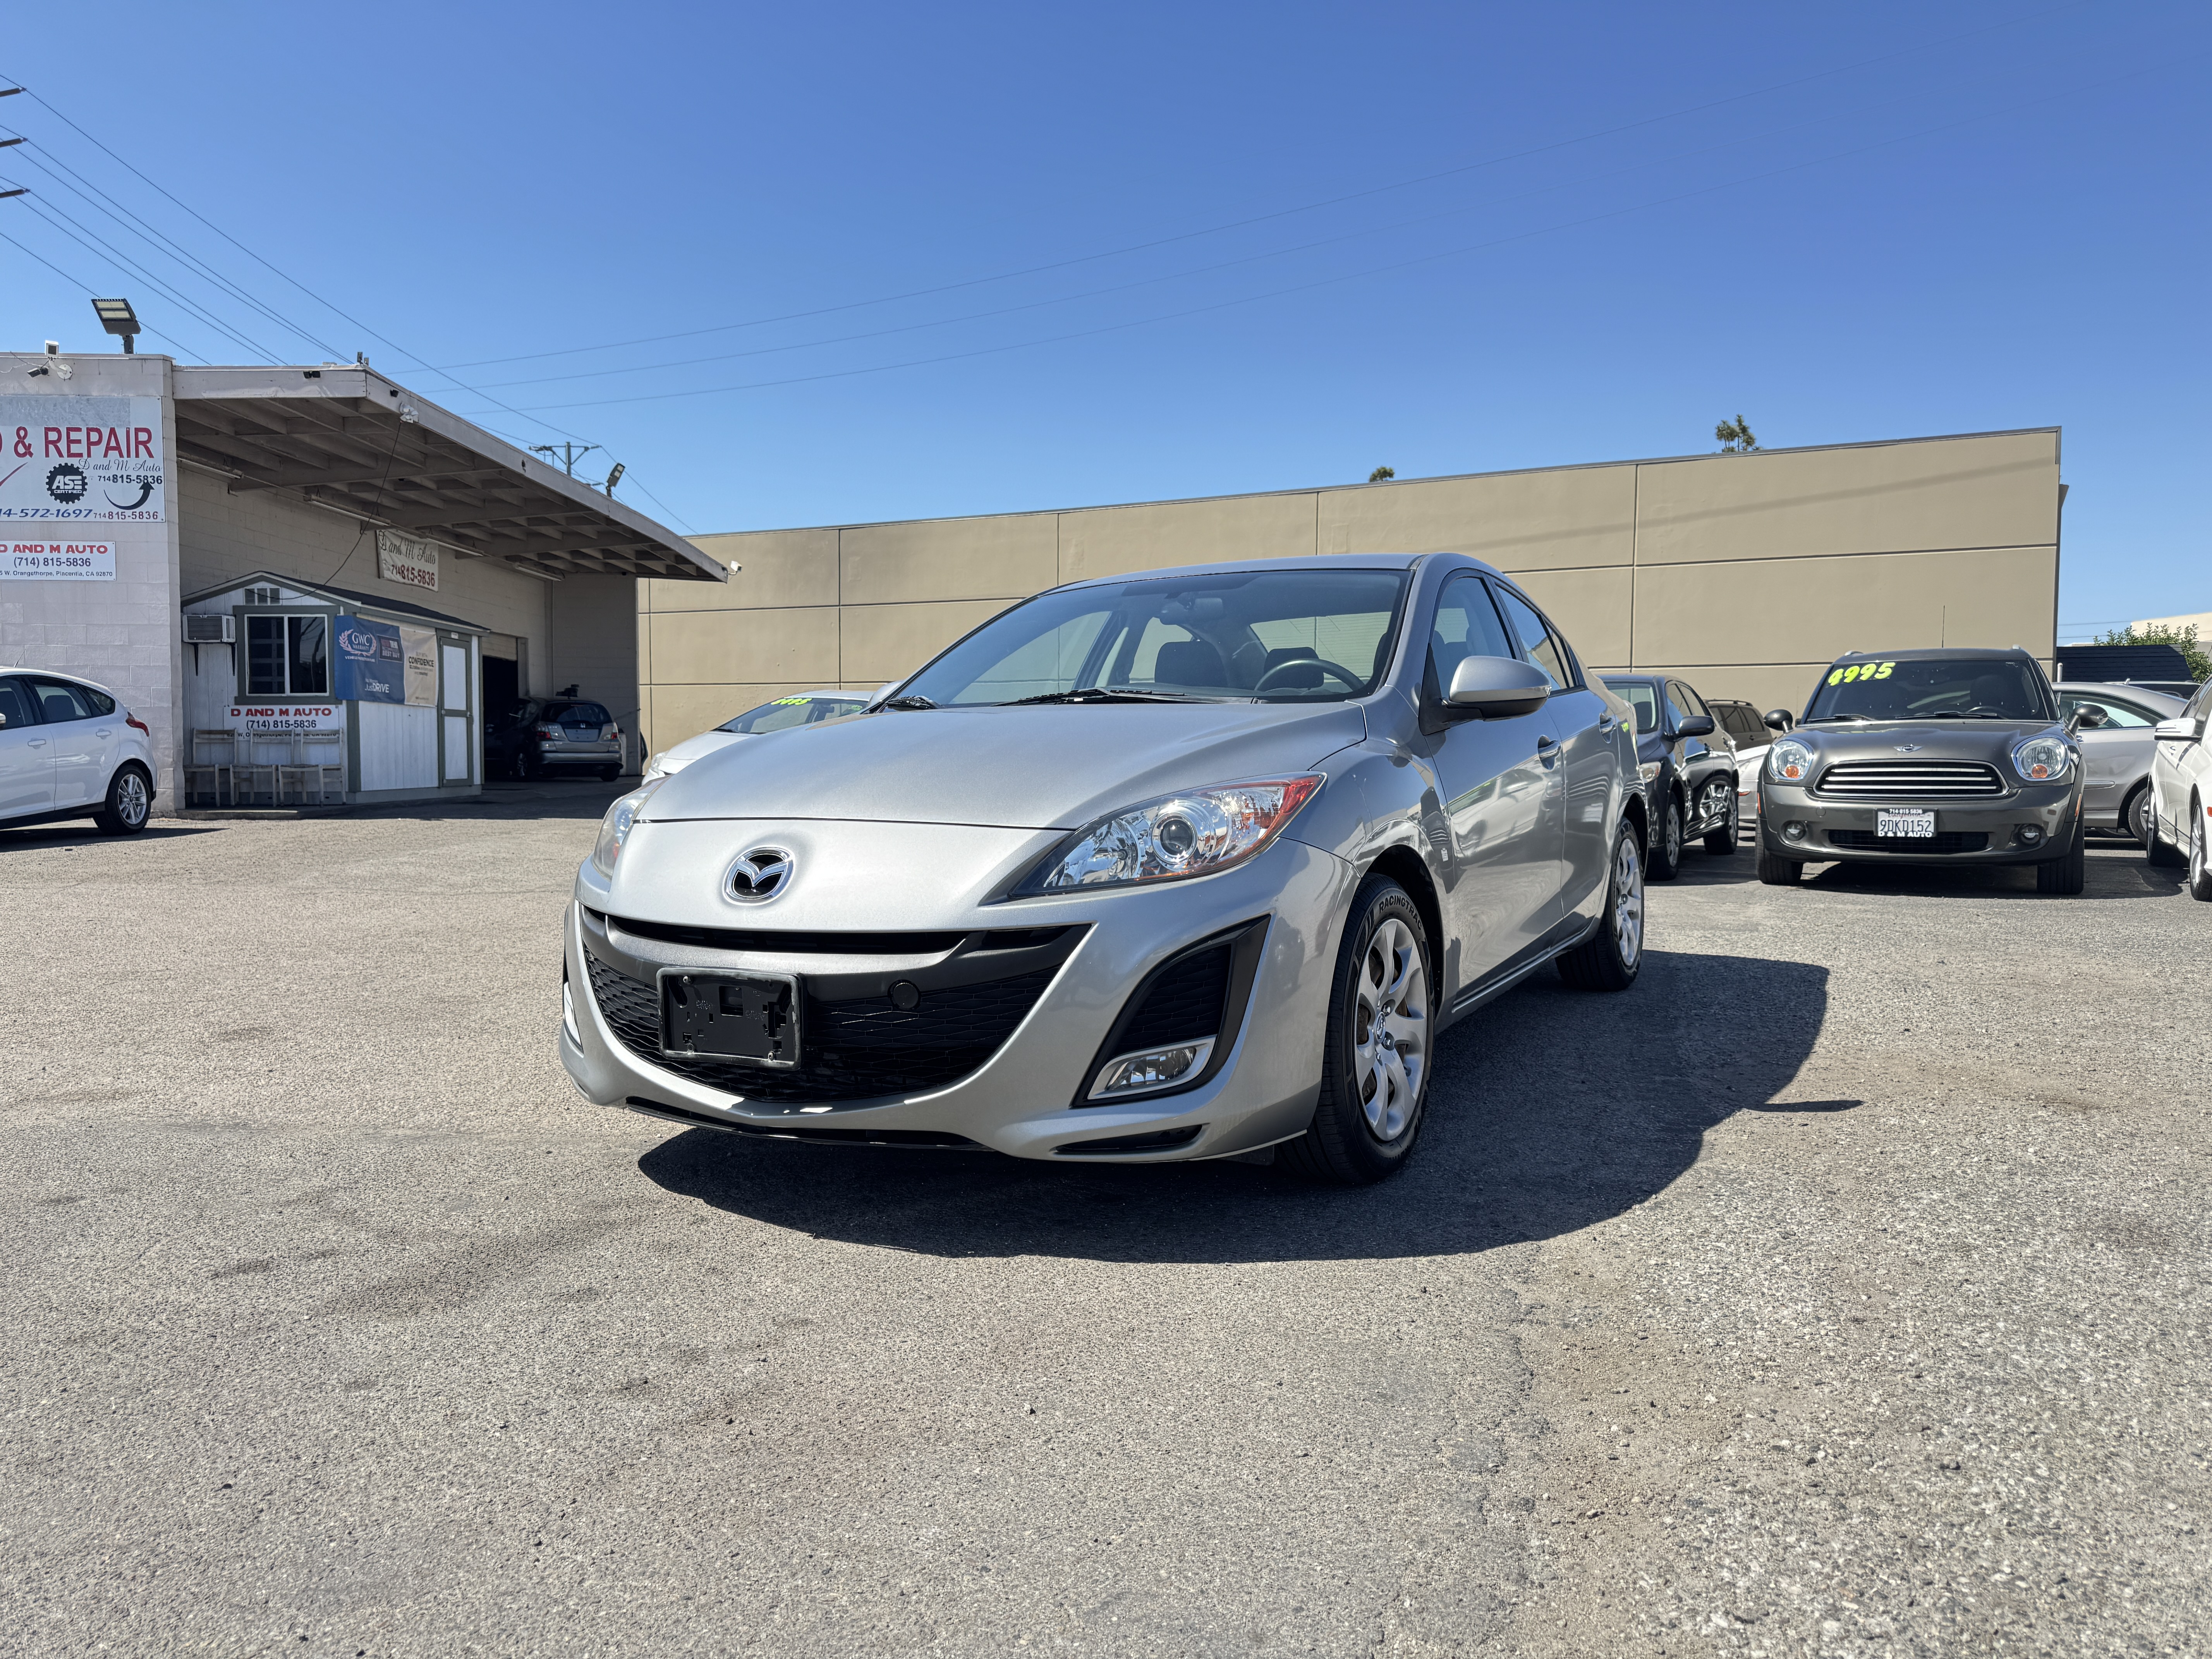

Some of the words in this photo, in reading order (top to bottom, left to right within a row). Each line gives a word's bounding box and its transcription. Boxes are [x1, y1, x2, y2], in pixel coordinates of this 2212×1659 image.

[14, 426, 34, 458] &
[44, 427, 155, 459] REPAIR
[93, 460, 112, 471] and
[114, 459, 130, 471] M
[133, 460, 162, 472] Auto
[52, 476, 82, 489] ASE
[13, 544, 45, 553] AND
[49, 544, 60, 553] M
[65, 545, 108, 554] AUTO
[388, 538, 403, 555] and
[405, 538, 415, 559] M
[417, 543, 435, 565] Auto
[14, 557, 40, 568] (714)
[43, 558, 91, 567] 815-5836
[352, 632, 370, 646] GWC
[409, 656, 434, 667] CONFIDENCE
[1828, 662, 1896, 686] 4995
[231, 708, 241, 716] D
[246, 708, 275, 716] AND
[279, 708, 289, 716] M
[294, 708, 332, 716] AUTO
[246, 720, 270, 730] (714)
[273, 720, 316, 728] 815-5836
[1880, 819, 1932, 832] 9DKD152
